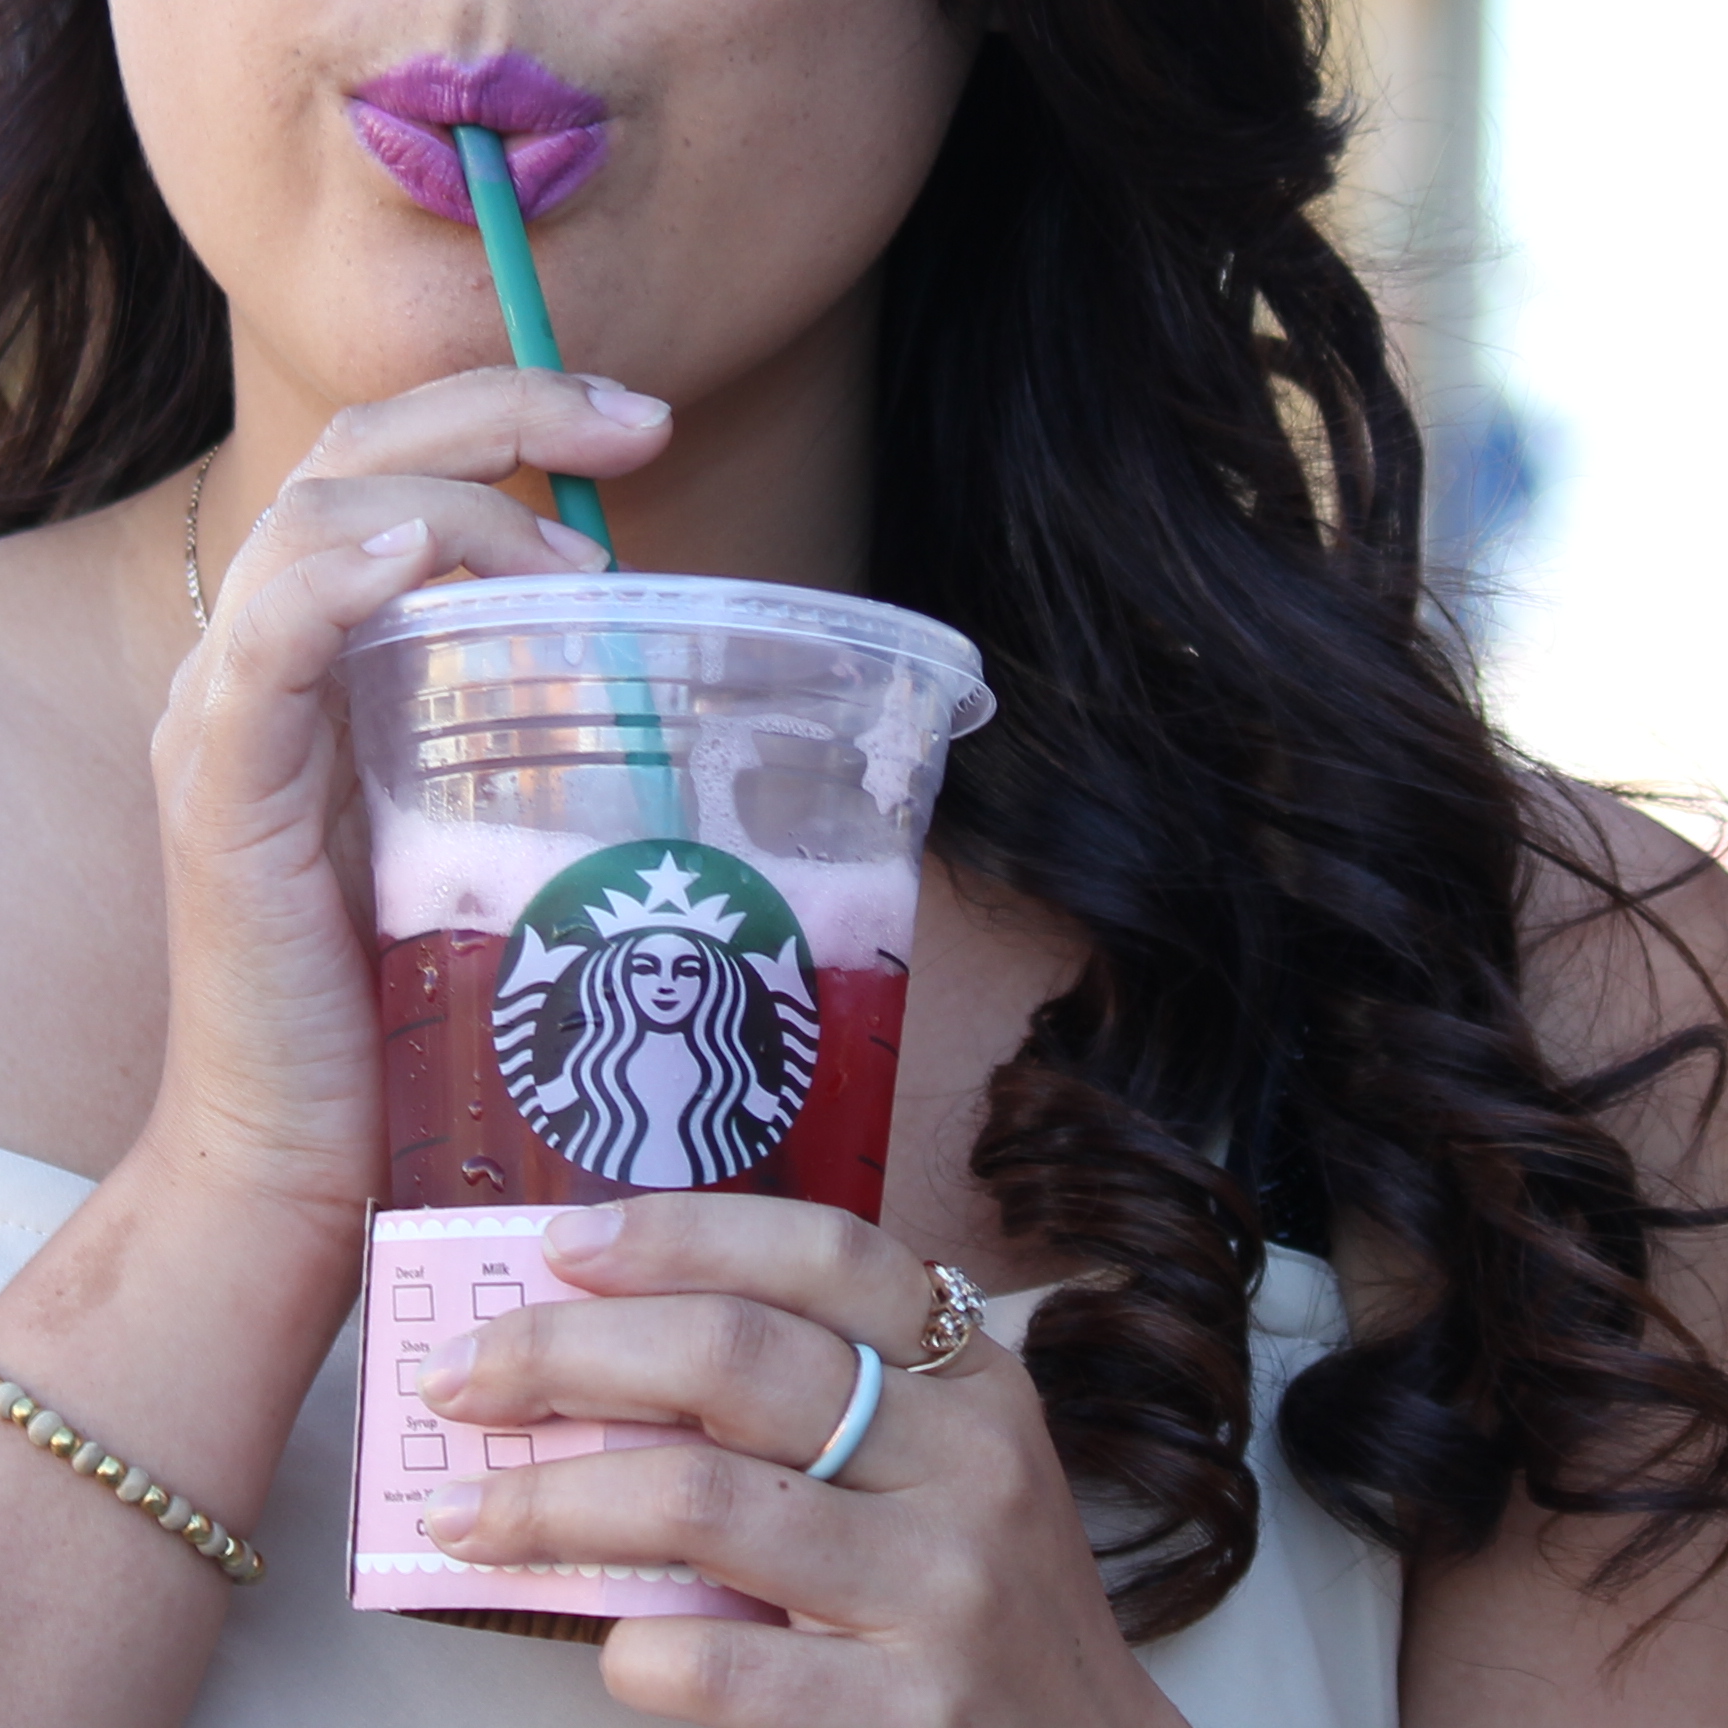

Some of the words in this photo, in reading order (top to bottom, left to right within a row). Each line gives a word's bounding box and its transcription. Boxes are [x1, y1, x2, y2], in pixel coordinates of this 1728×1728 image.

[394, 1264, 425, 1280] Decaf
[481, 1262, 510, 1277] Milk
[400, 1339, 431, 1354] Shots
[405, 1415, 439, 1432] Syrup
